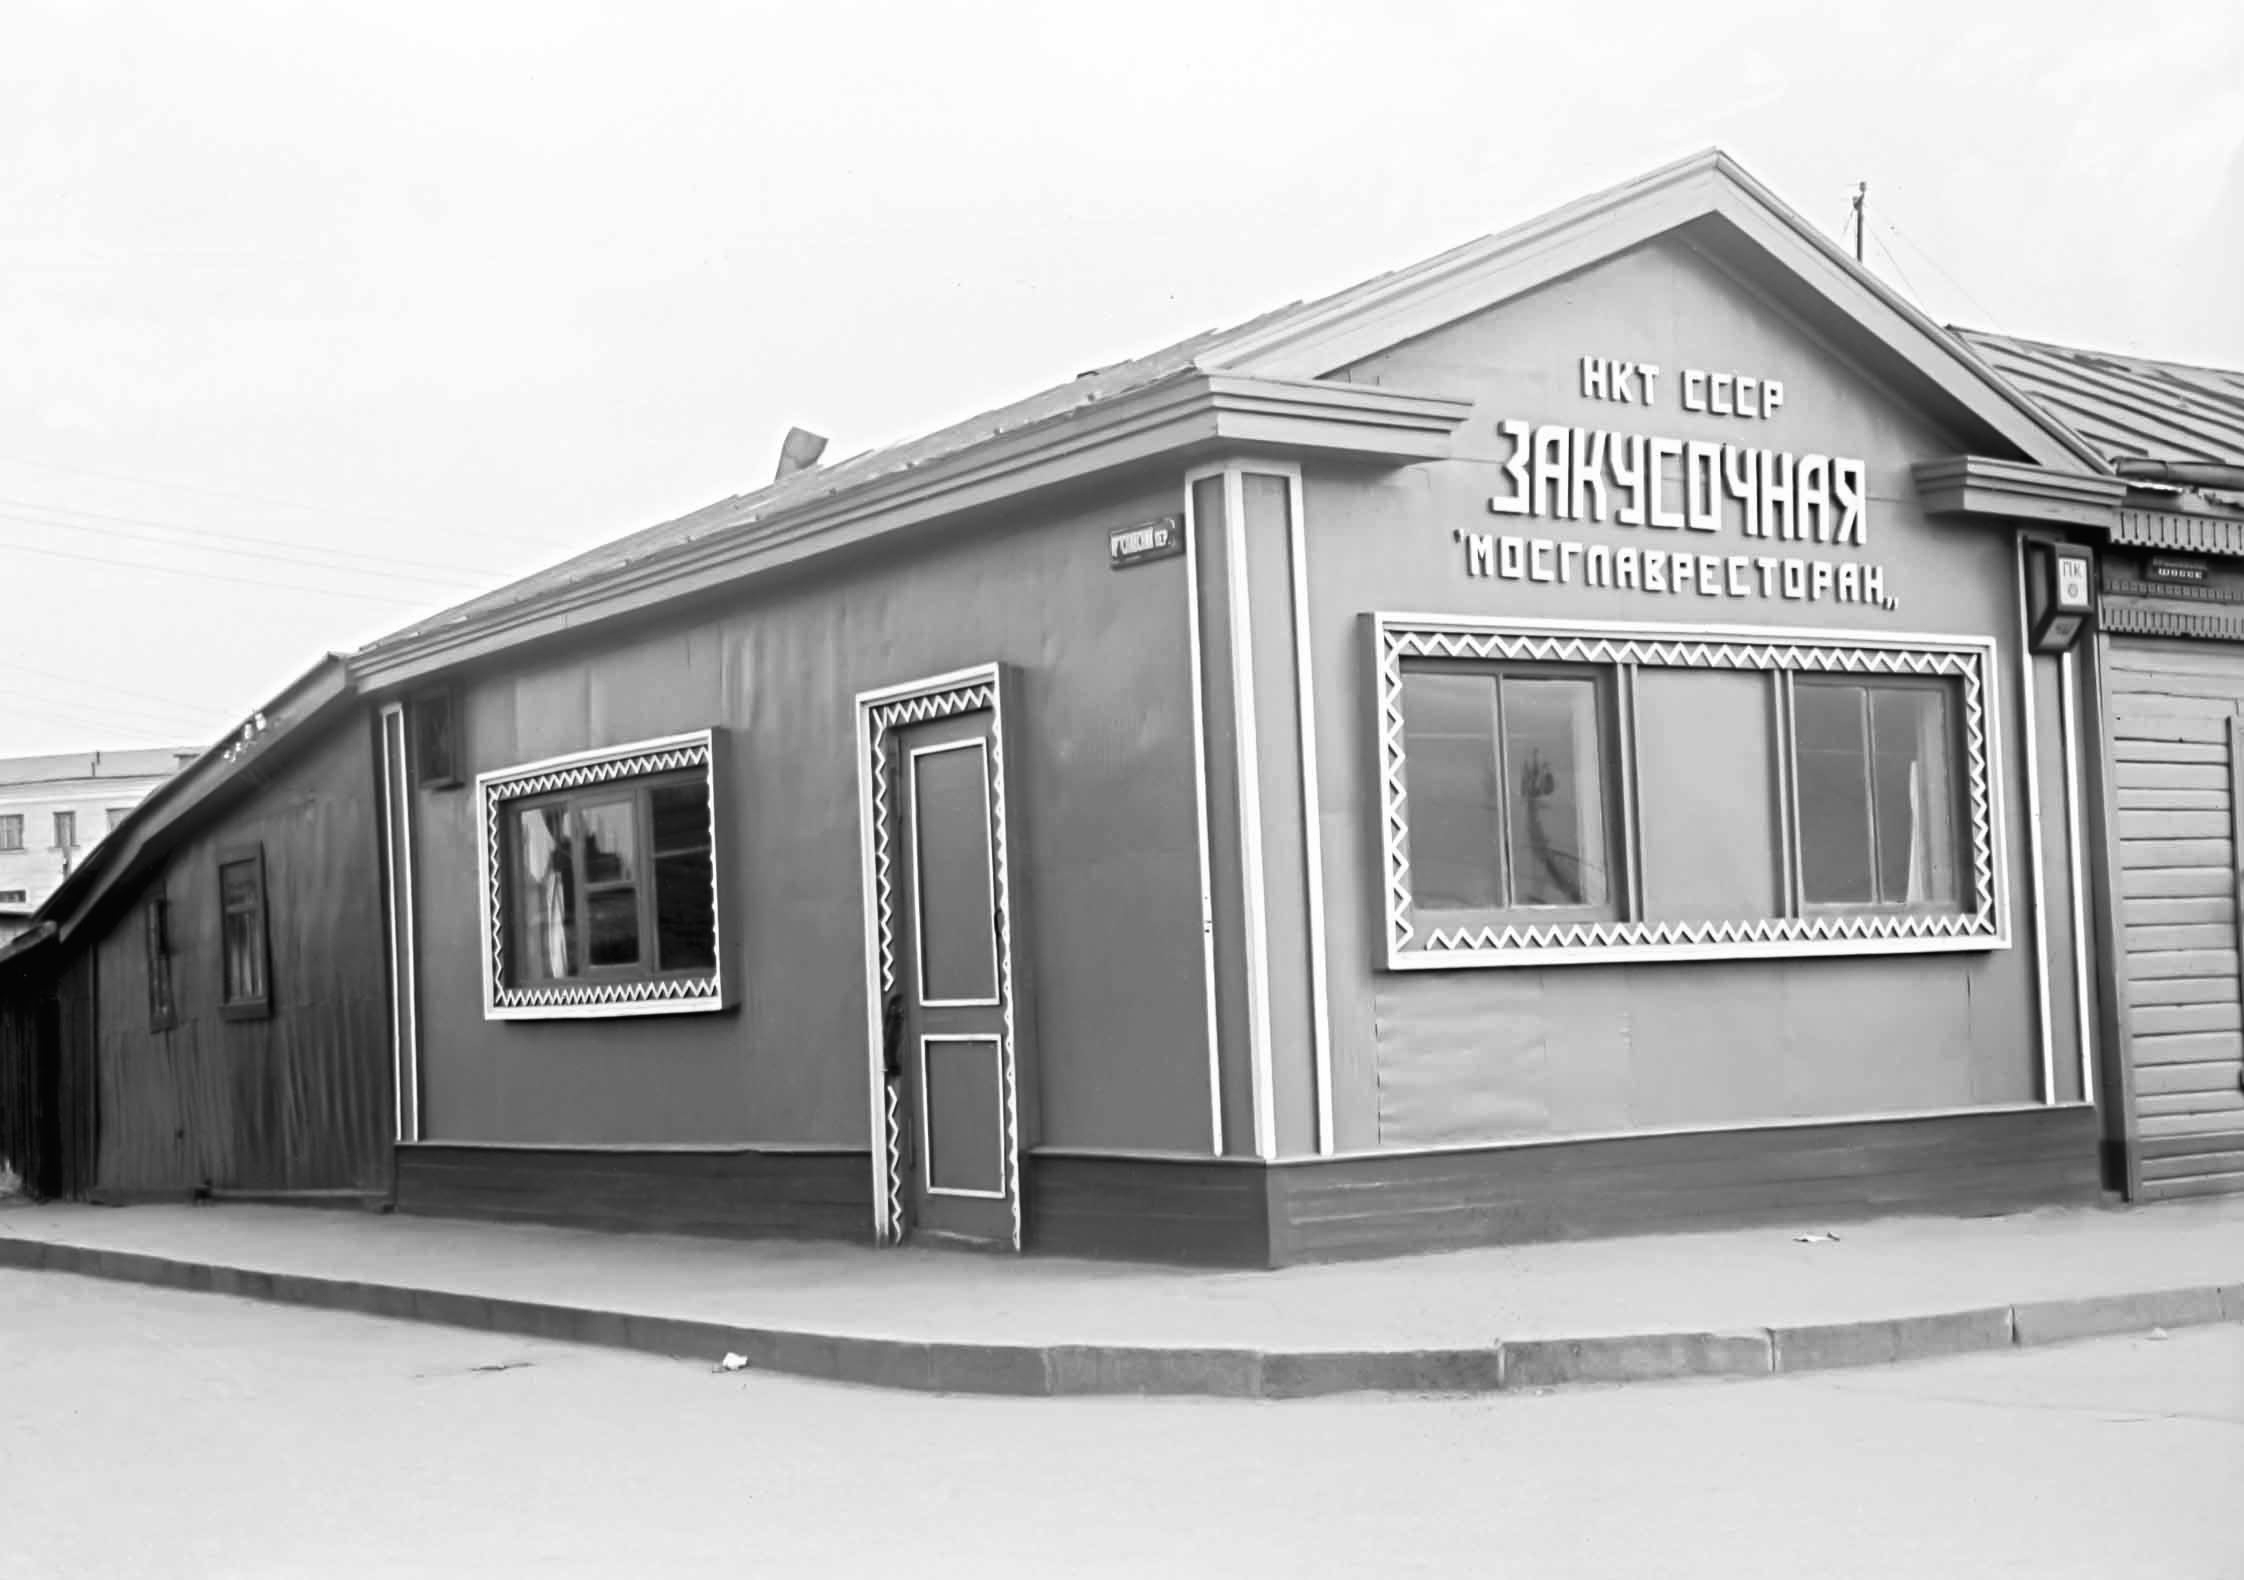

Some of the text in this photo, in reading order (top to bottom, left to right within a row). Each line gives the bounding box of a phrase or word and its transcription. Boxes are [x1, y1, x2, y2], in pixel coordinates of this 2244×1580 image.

[1582, 355, 1784, 418] НКТ СССР
[1491, 419, 1867, 544] ЗАКУСОЧНАЯ
